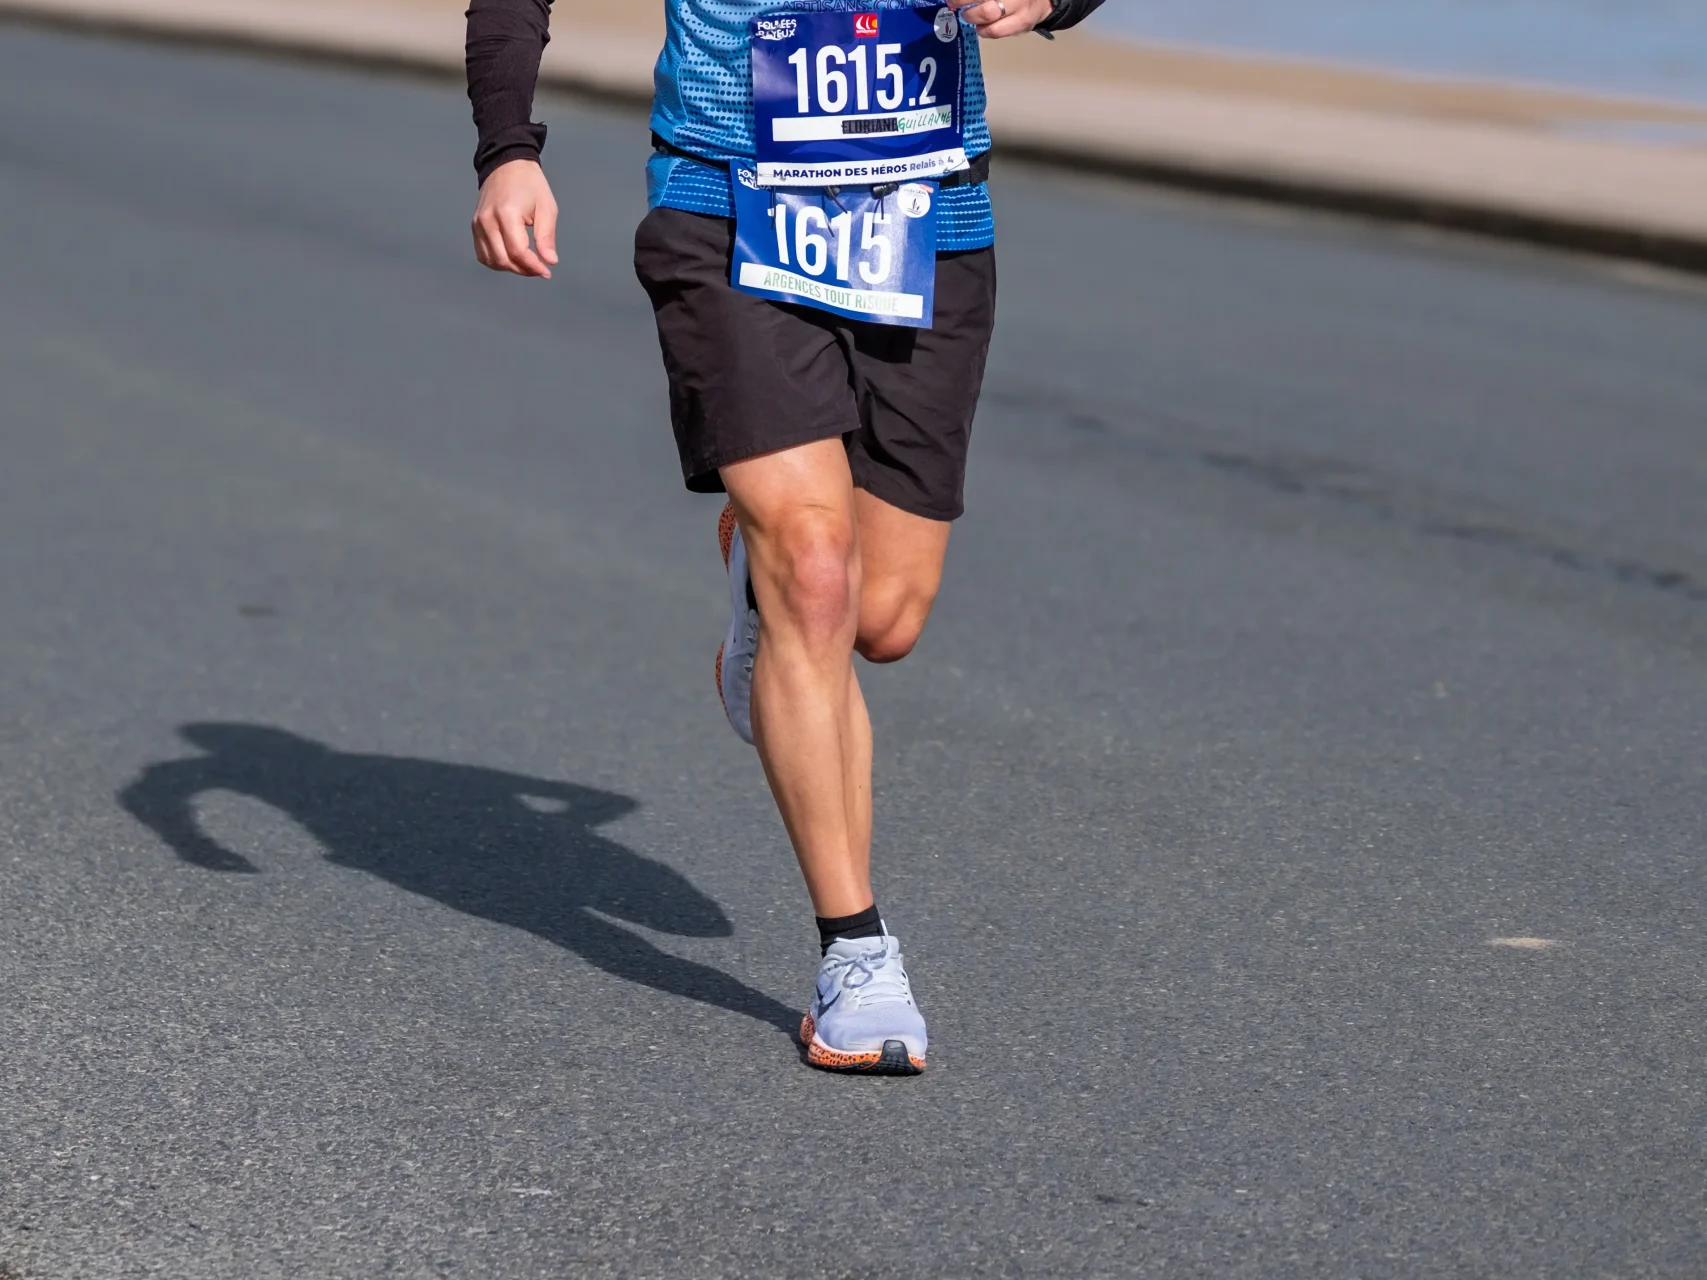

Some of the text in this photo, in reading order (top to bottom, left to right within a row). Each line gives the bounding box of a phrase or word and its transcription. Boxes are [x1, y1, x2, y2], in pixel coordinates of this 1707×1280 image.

[788, 43, 938, 114] 1615.2
[773, 168, 842, 179] MARATHON
[845, 168, 868, 177] DES
[871, 163, 908, 176] HÉROS
[910, 158, 936, 171] Relais
[767, 203, 893, 285] 1615
[764, 271, 822, 299] ARGENCES
[824, 287, 852, 307] TOUT
